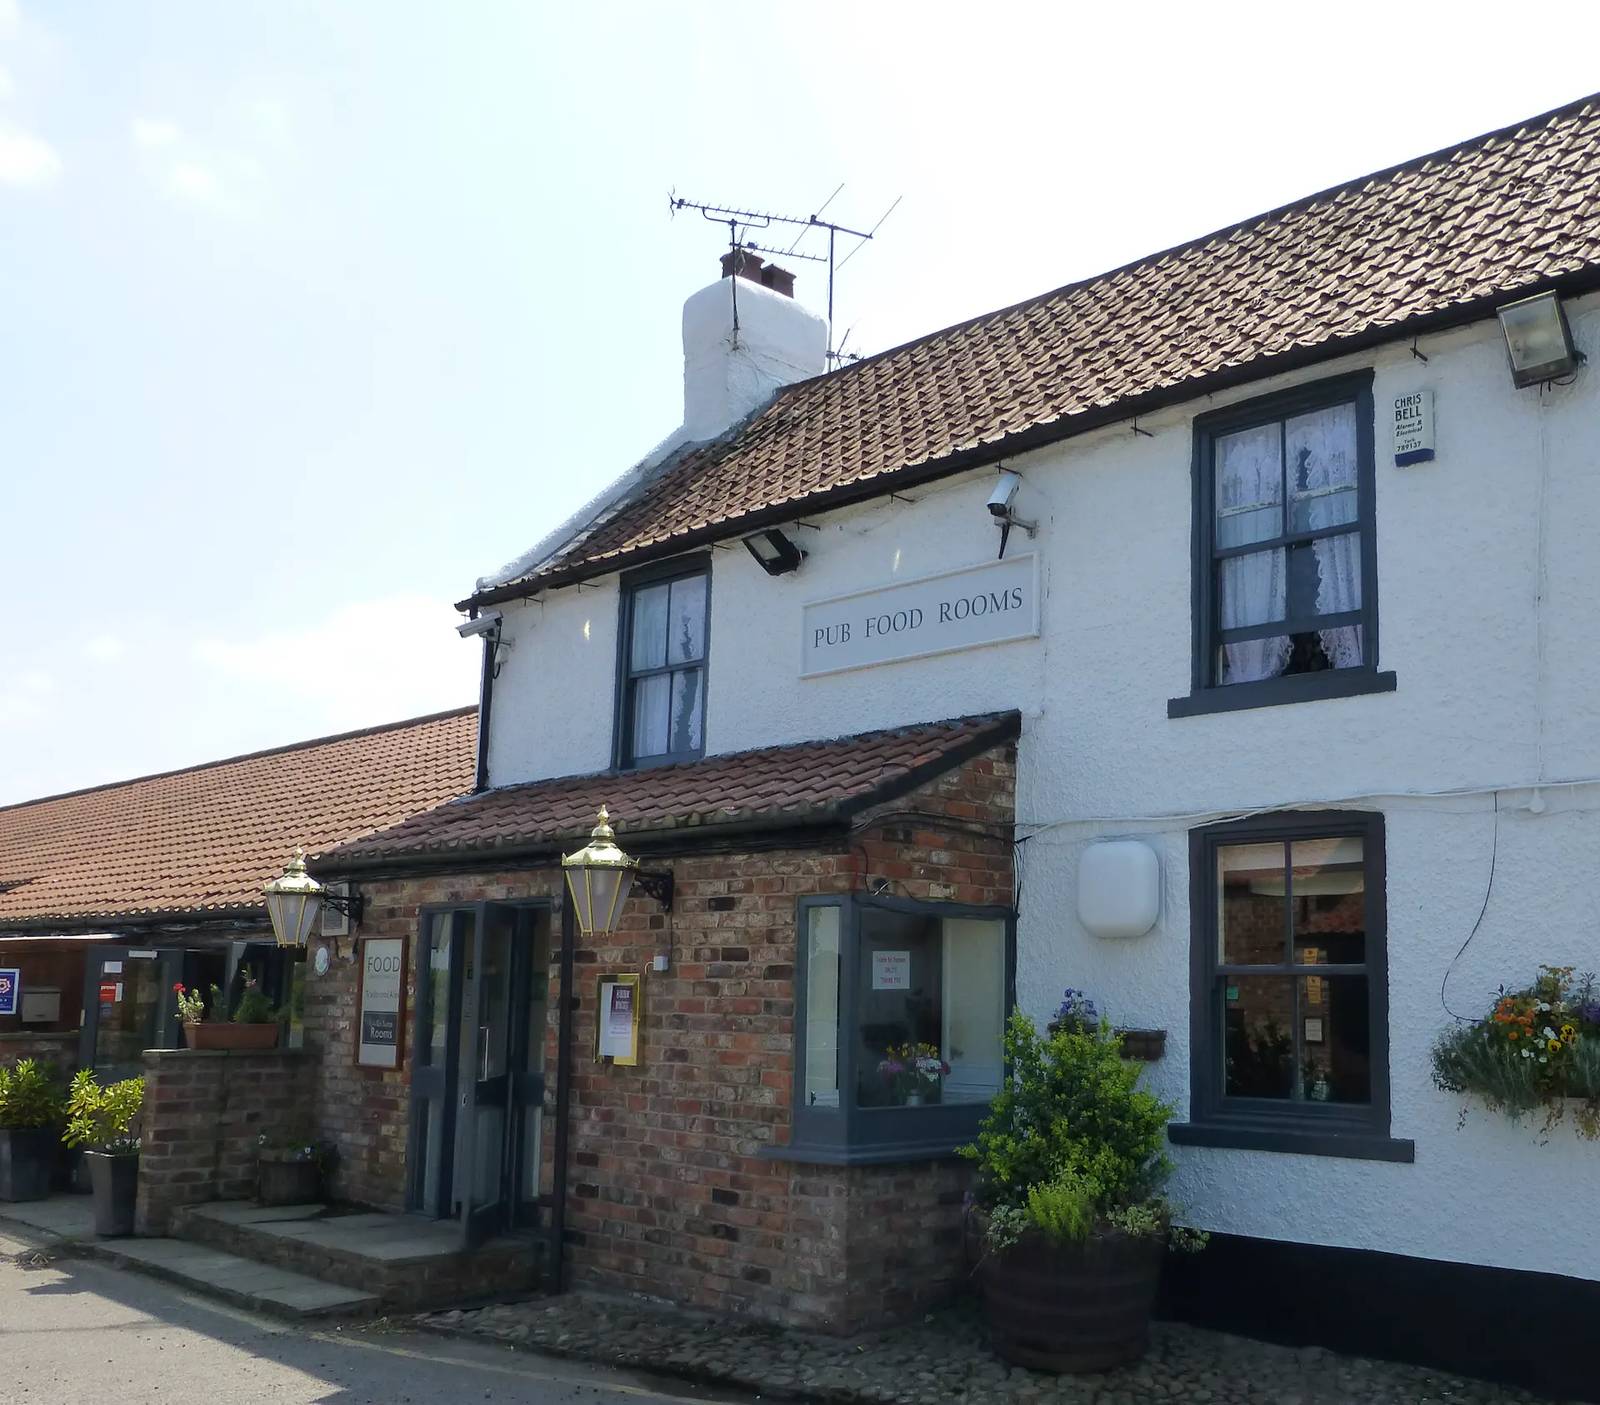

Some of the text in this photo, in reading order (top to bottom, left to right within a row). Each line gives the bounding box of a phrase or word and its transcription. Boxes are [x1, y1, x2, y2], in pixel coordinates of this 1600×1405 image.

[1395, 393, 1421, 409] CHRIS
[1395, 406, 1422, 421] BELL
[814, 587, 1023, 649] PUB FOOD ROOMS
[367, 956, 400, 973] FOOD
[370, 1027, 393, 1039] Rooms
